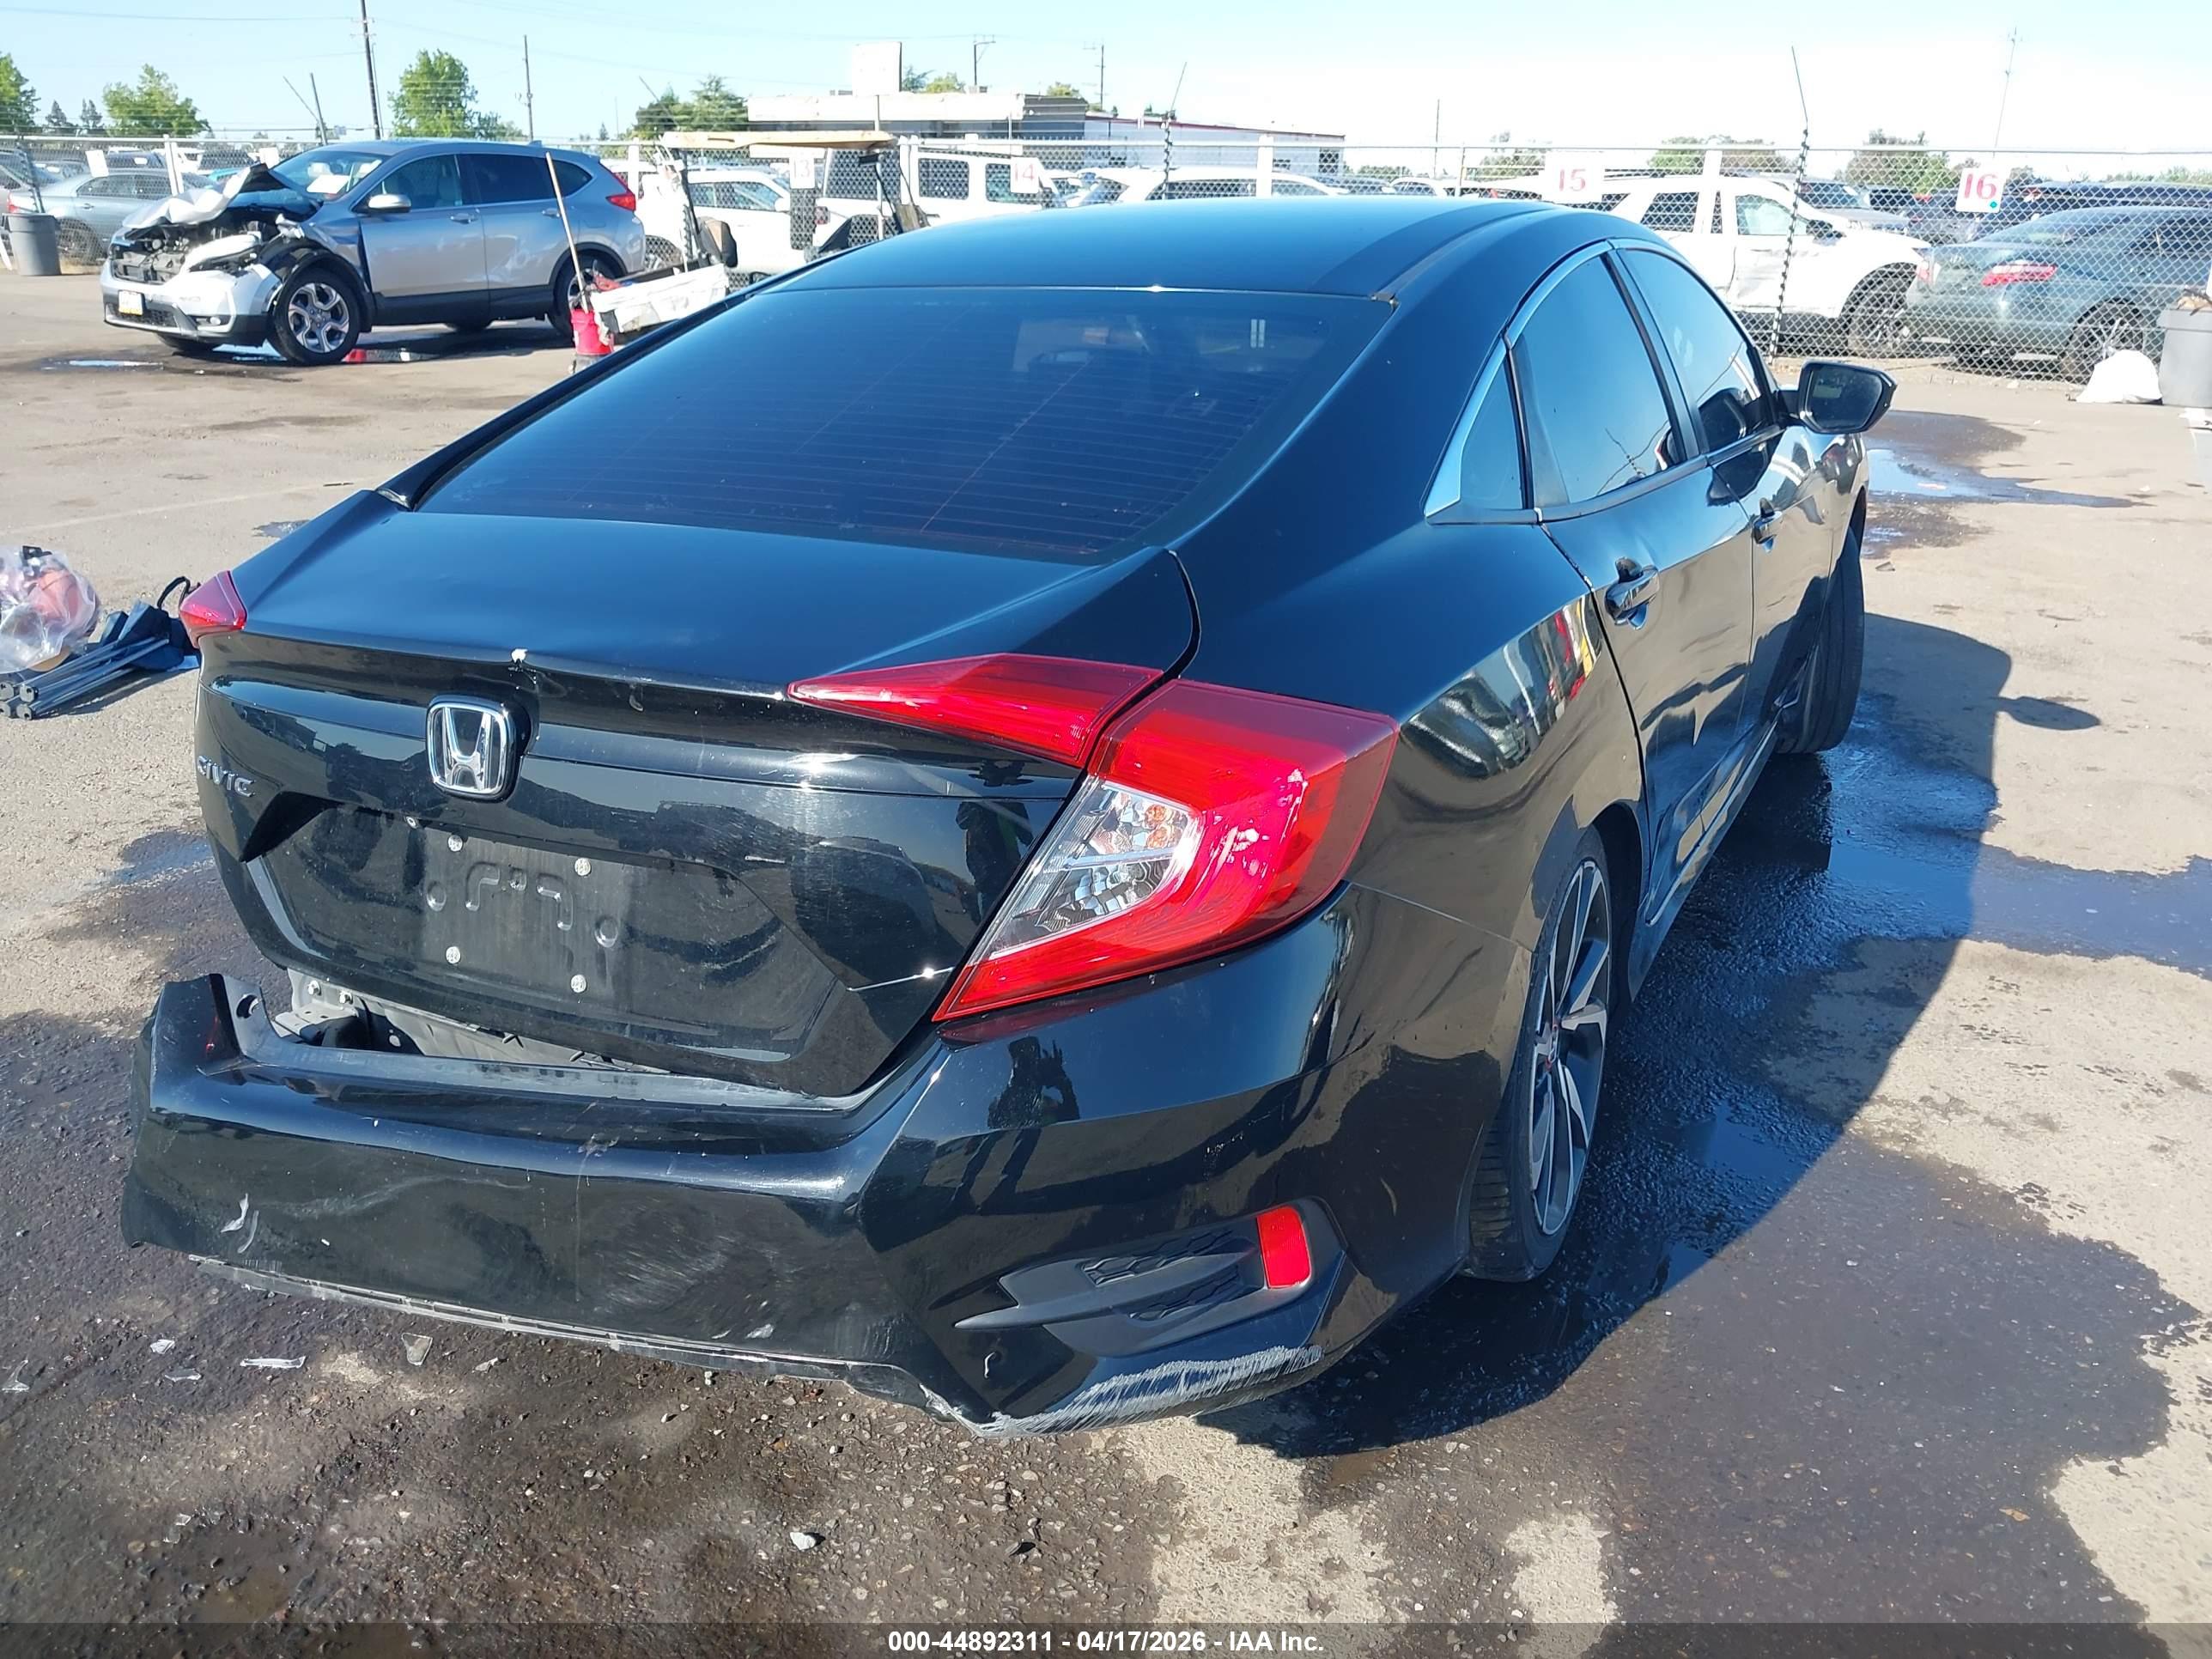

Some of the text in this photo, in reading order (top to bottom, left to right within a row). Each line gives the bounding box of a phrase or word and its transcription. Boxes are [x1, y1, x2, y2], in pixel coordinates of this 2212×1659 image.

[1015, 163, 1035, 181] 14
[1559, 168, 1586, 191] 15
[1964, 173, 1997, 199] 16
[197, 755, 256, 798] CIVIC
